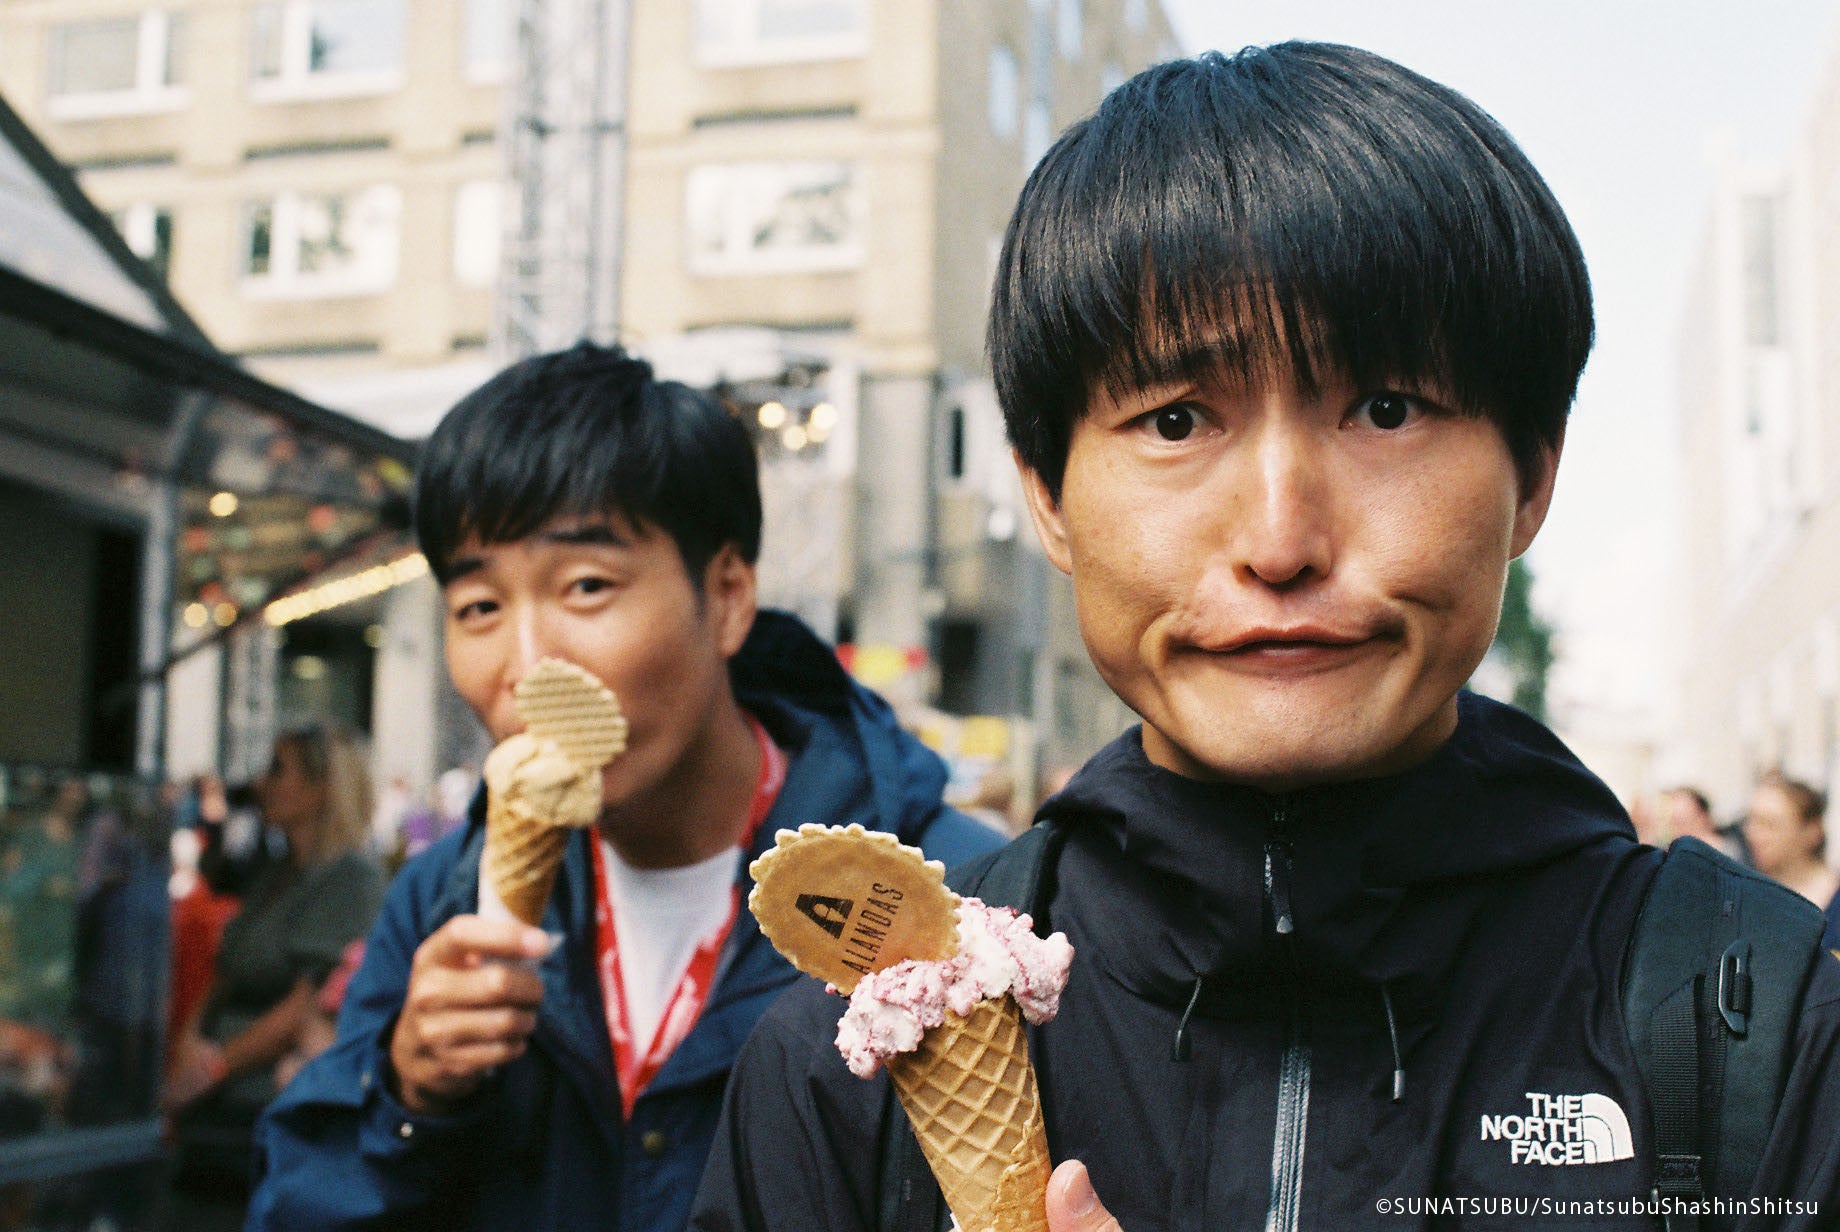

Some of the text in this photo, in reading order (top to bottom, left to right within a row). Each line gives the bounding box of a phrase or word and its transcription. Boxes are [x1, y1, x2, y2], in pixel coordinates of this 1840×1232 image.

[795, 893, 855, 940] A
[1525, 1092, 1583, 1118] THE
[1481, 1114, 1584, 1142] NORTH
[1511, 1139, 1586, 1166] FACE
